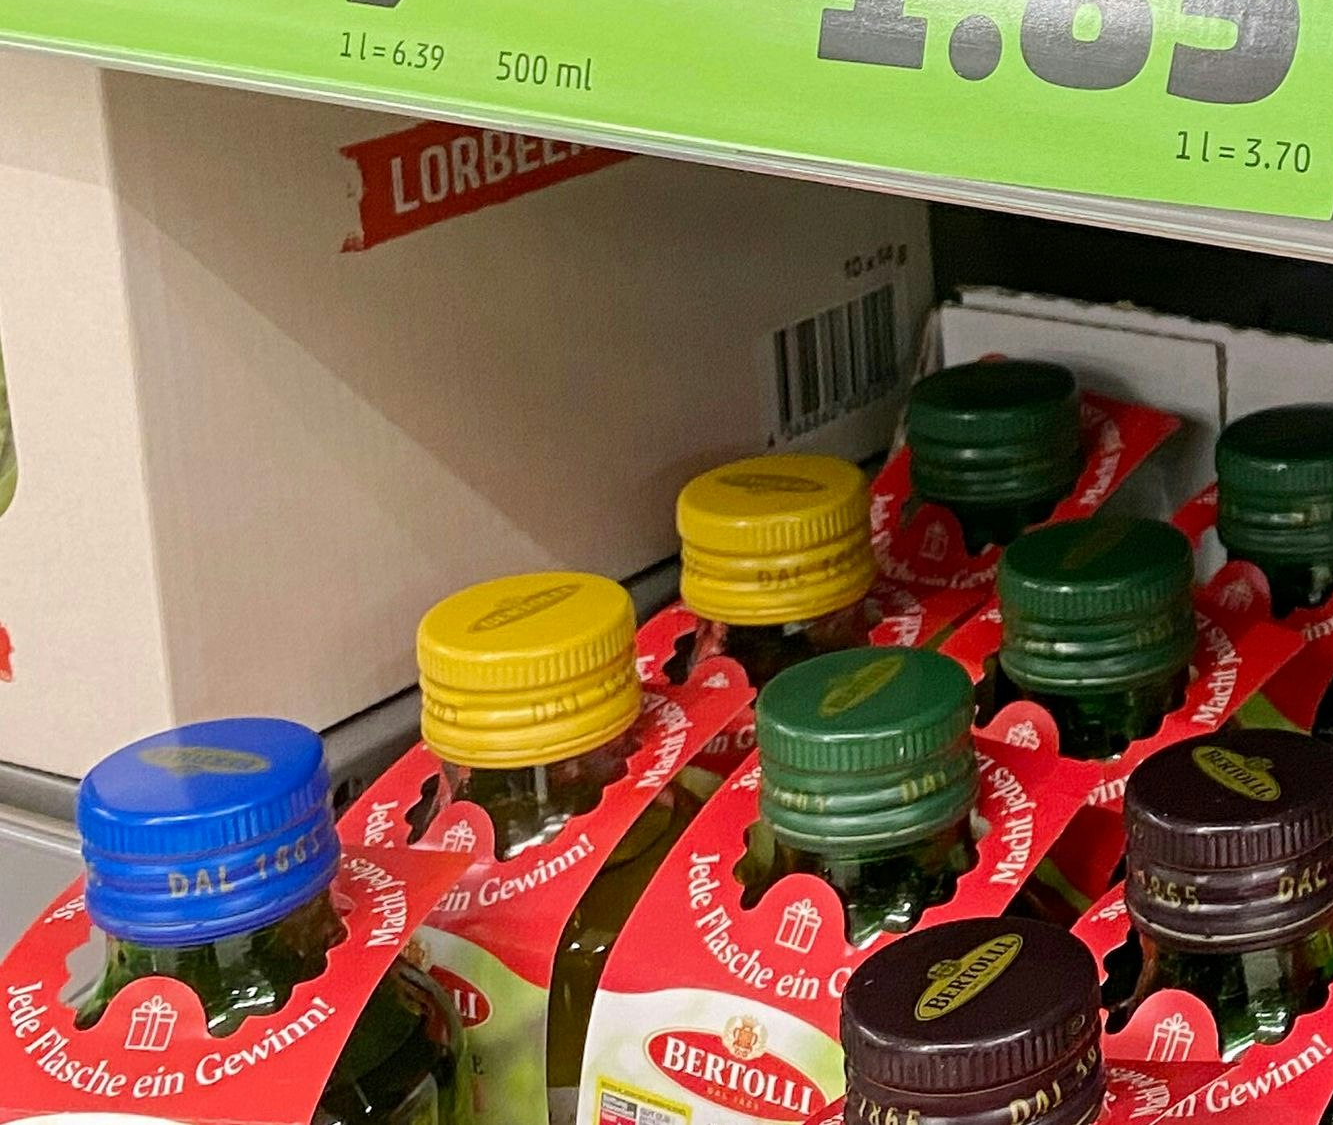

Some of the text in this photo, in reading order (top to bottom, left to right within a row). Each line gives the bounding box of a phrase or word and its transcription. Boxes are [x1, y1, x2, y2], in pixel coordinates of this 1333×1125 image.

[393, 40, 445, 71] 6.39
[496, 50, 592, 91] 500 ml
[1244, 139, 1312, 174] 3.70
[364, 800, 400, 847] Jede
[989, 814, 1034, 886] Macht
[168, 865, 235, 899] DAL
[478, 833, 596, 907] Gewinn!
[366, 889, 408, 948] Macht
[689, 852, 821, 1000] Jede Flasche ein
[924, 938, 1018, 1011] BERTOLLI
[7, 980, 337, 1099] Jede Flasche ein Gewinn!
[662, 1035, 815, 1116] BERTOLLI
